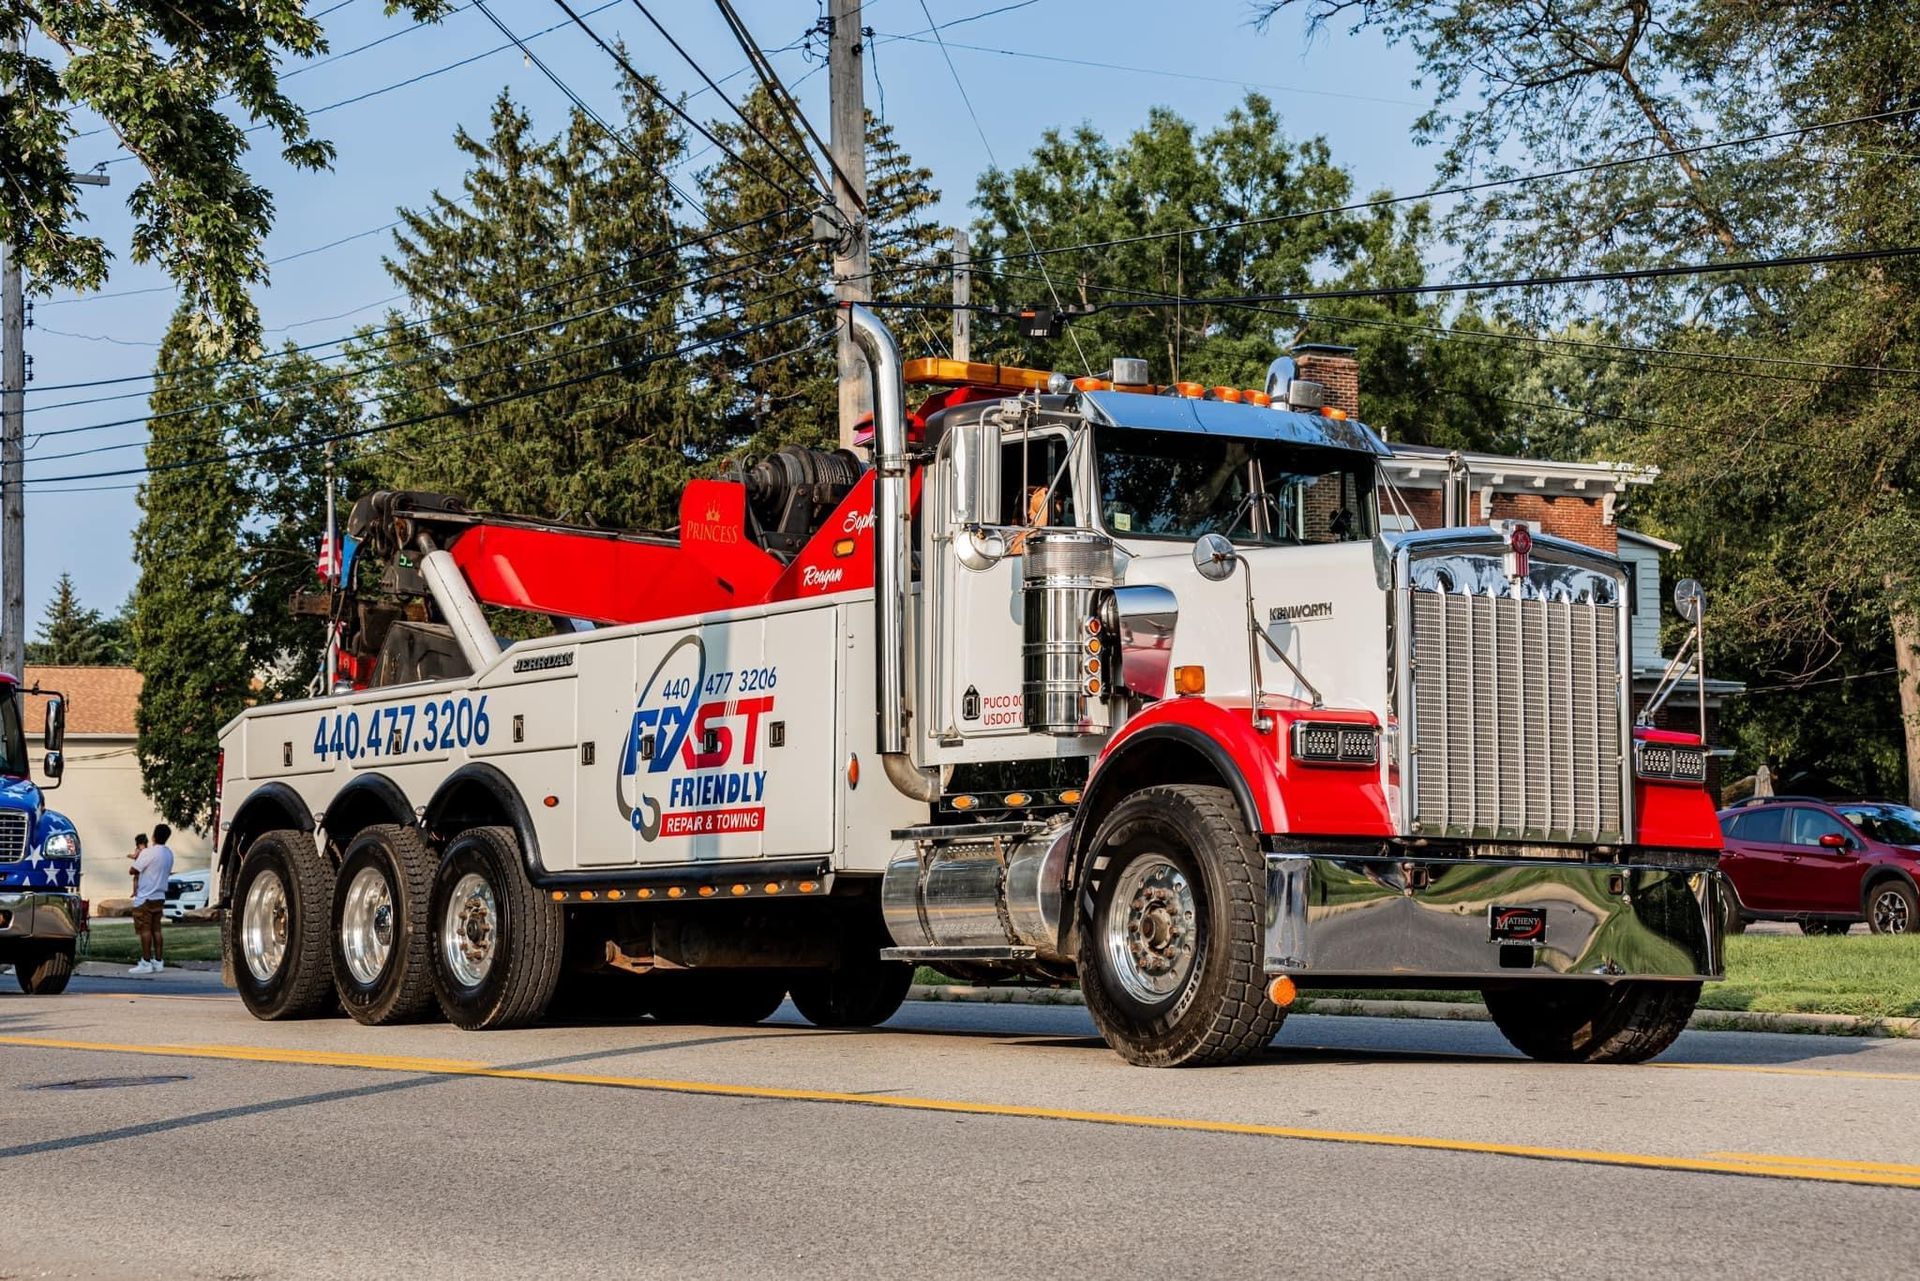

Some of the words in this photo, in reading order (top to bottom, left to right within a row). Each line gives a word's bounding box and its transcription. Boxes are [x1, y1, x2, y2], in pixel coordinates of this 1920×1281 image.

[686, 520, 738, 544] PRINCESS
[843, 506, 875, 536] Soph
[803, 565, 843, 591] Reagan
[1269, 602, 1332, 621] KENWORTH
[662, 677, 690, 700] 440
[705, 672, 734, 695] 477
[738, 666, 777, 692] 3206
[984, 695, 1010, 709] PUCO
[313, 695, 490, 762] 440.477.3206
[984, 712, 1016, 725] USDOT
[622, 696, 775, 775] FAST
[669, 770, 767, 808] FRIENDLY
[666, 813, 703, 833] REPAIR
[705, 815, 713, 829] &
[716, 812, 759, 829] TOWING
[1495, 917, 1540, 930] MATHENY
